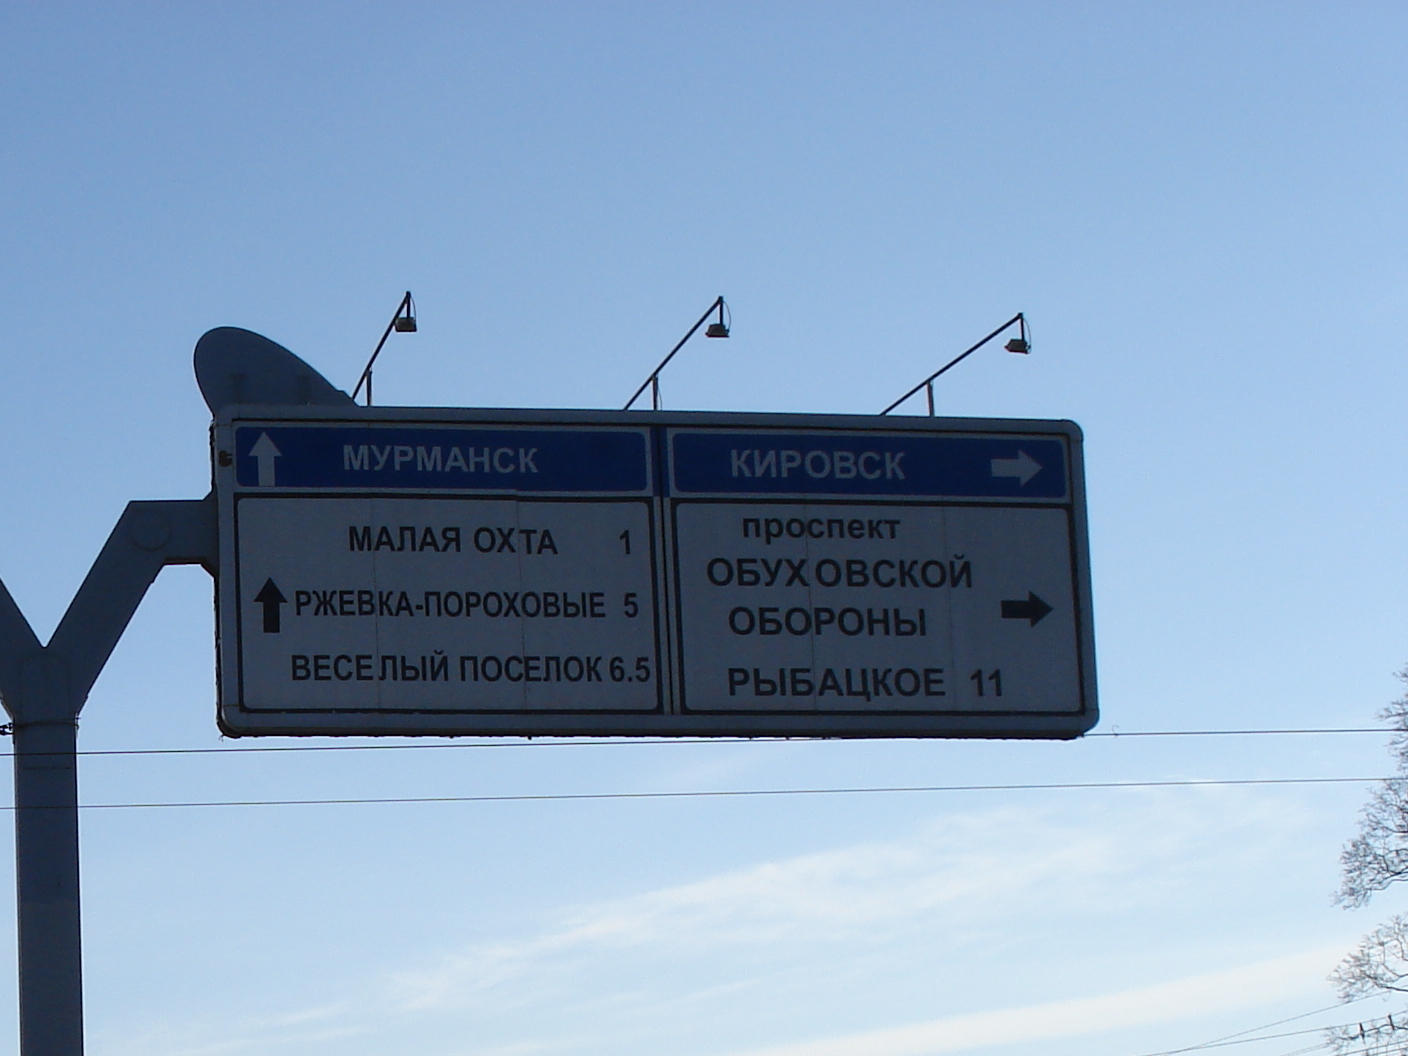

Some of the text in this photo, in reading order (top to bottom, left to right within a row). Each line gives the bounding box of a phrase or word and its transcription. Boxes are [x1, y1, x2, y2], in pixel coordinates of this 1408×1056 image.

[343, 444, 538, 474] МУРМАНСК
[730, 449, 906, 480] КИРОВСК
[348, 525, 631, 555] МАЛАЯ ОХТА 1
[742, 517, 901, 545] проспект
[706, 554, 973, 588] ОБУХОВСКОЙ
[294, 589, 639, 619] РЖЕВКА-ПОРОХОВЫЕ 5
[728, 606, 926, 636] ОБОРОНЫ
[292, 649, 651, 683] ВЕСЕЛЫЙ ПОСЕЛОК 6.5
[728, 667, 1003, 702] РЫБАЦКОЕ 11
